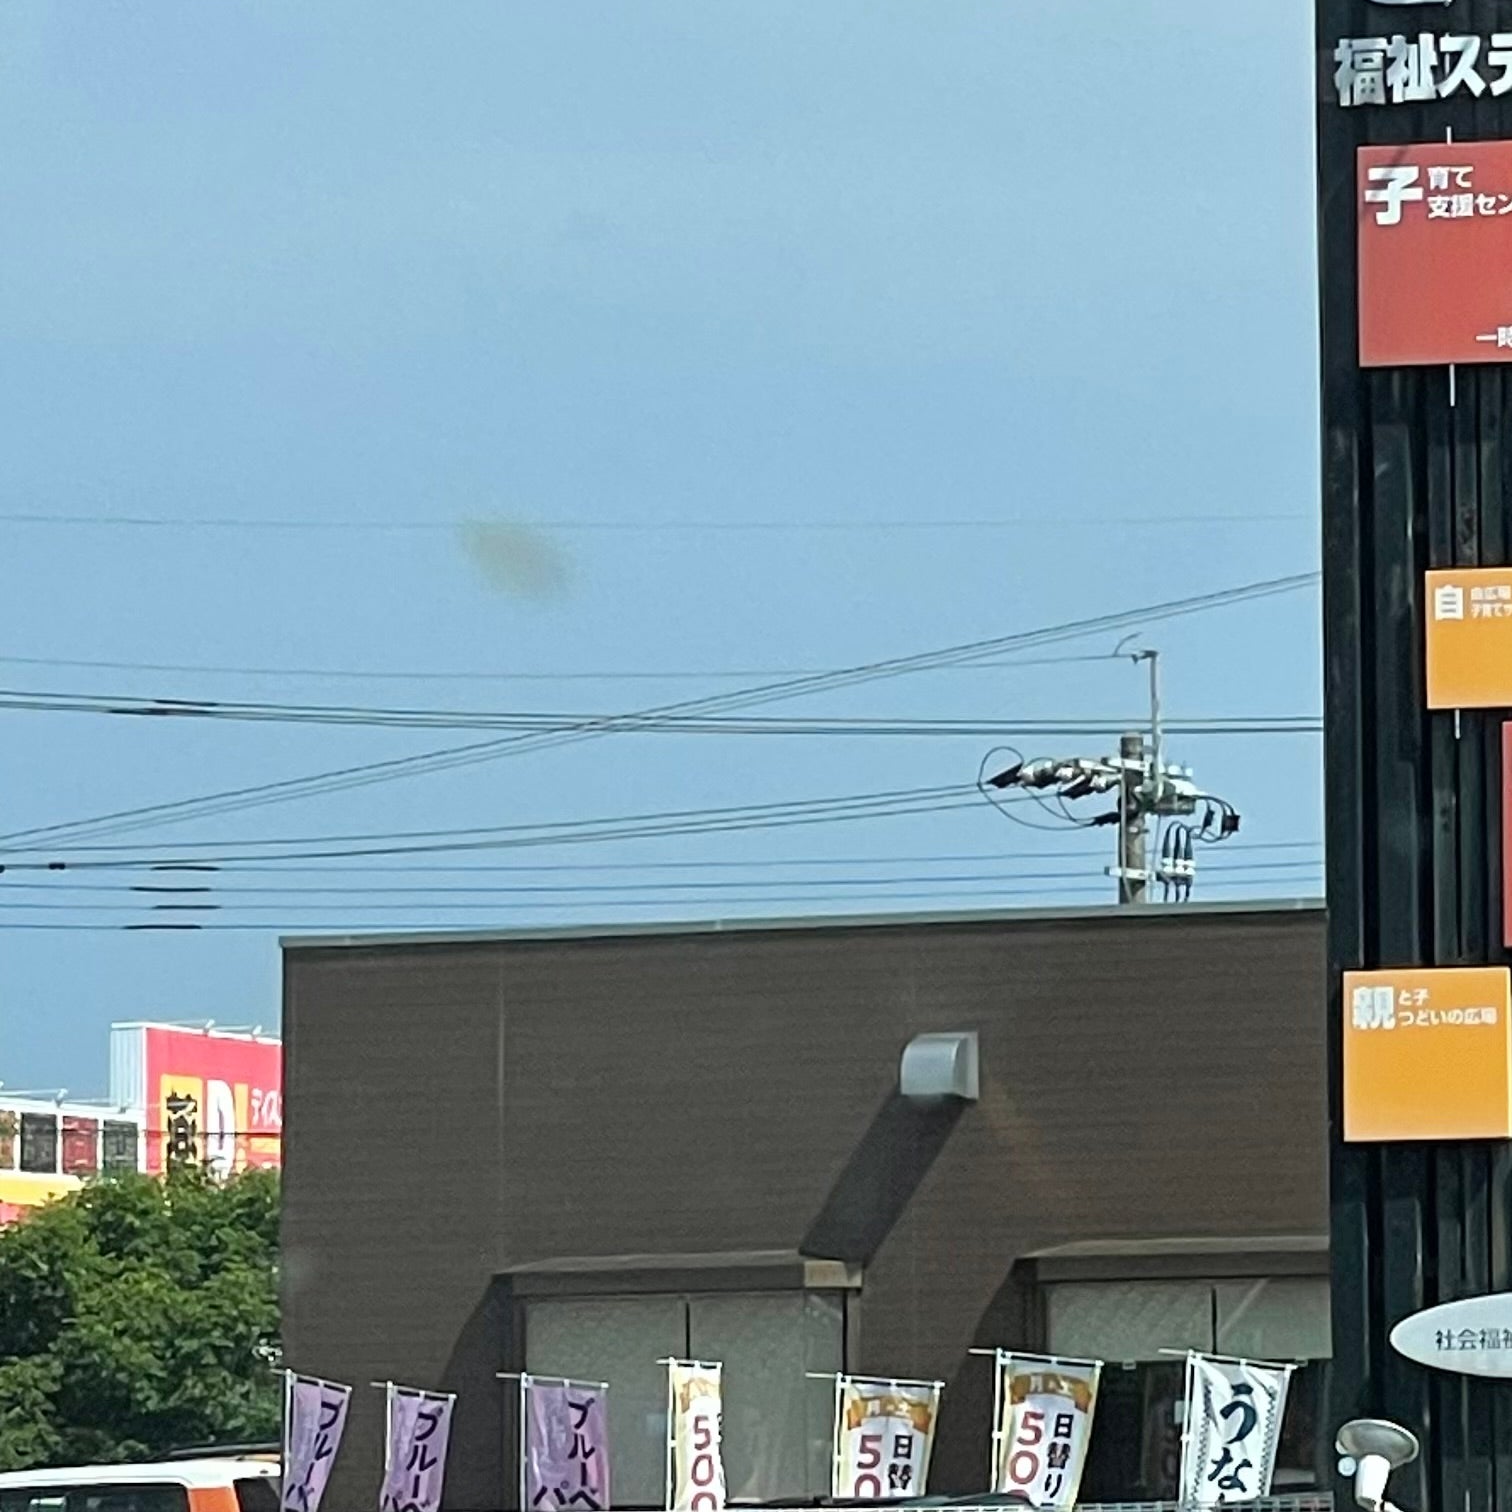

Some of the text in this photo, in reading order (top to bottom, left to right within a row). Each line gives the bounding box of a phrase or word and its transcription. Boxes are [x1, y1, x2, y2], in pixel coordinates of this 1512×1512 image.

[1044, 1413, 1074, 1506] 日替り
[1207, 1383, 1257, 1506] うな
